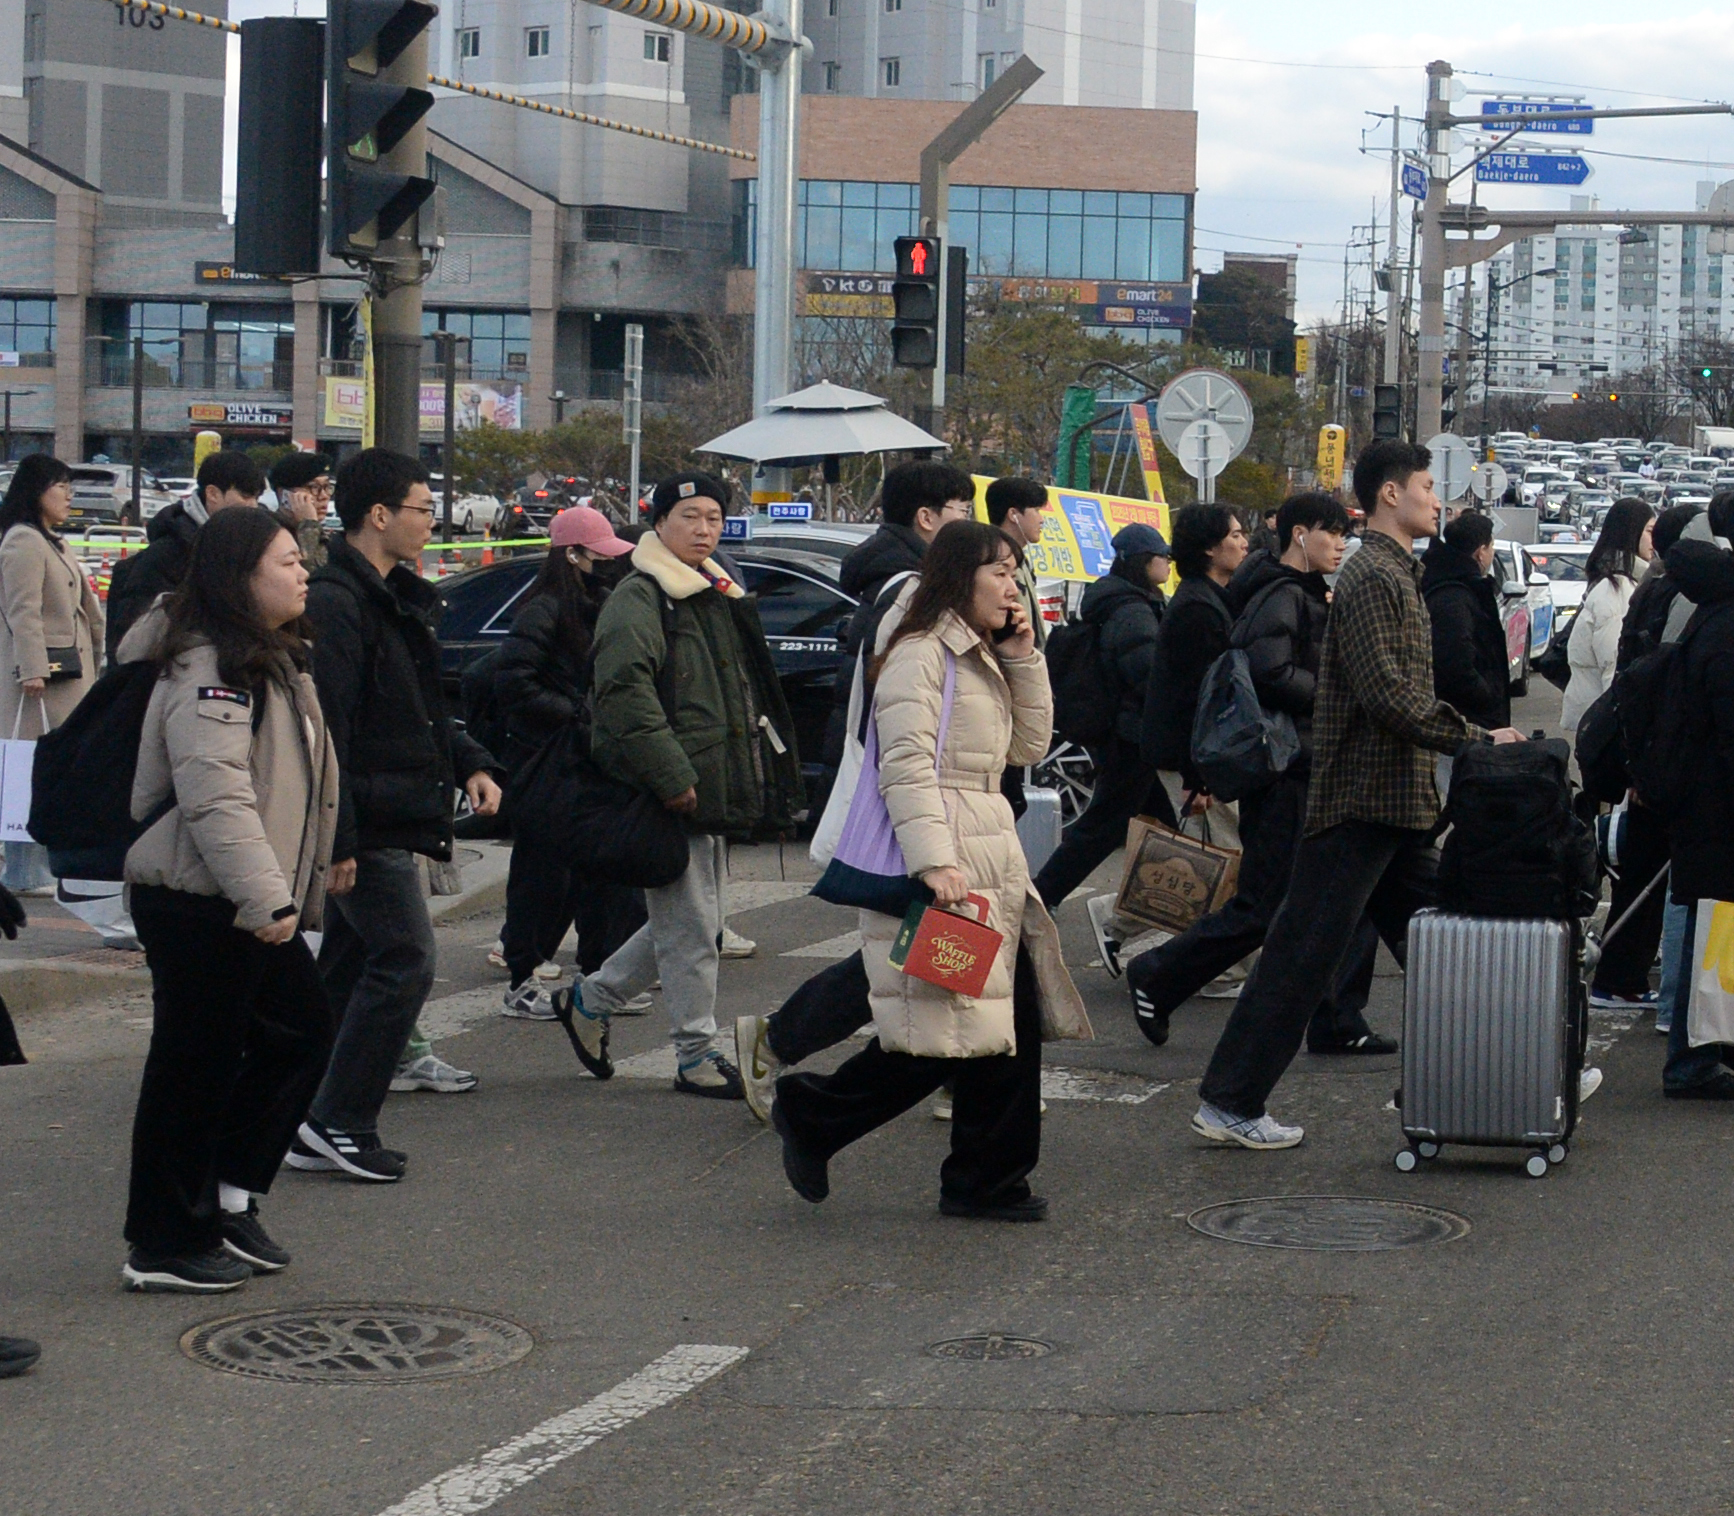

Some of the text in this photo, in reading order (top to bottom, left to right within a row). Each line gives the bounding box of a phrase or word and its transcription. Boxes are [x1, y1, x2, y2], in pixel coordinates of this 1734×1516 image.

[1478, 169, 1540, 181] Baekje-daero
[839, 279, 855, 292] kt
[1116, 287, 1173, 303] emart24
[227, 402, 262, 414] OLIVE
[227, 413, 278, 425] CHICKEN
[772, 506, 806, 517] 전주사랑
[779, 641, 837, 652] 223-1114
[1150, 870, 1196, 896] 성심당
[931, 937, 977, 966] WAFFLE
[931, 951, 966, 971] SHOP
